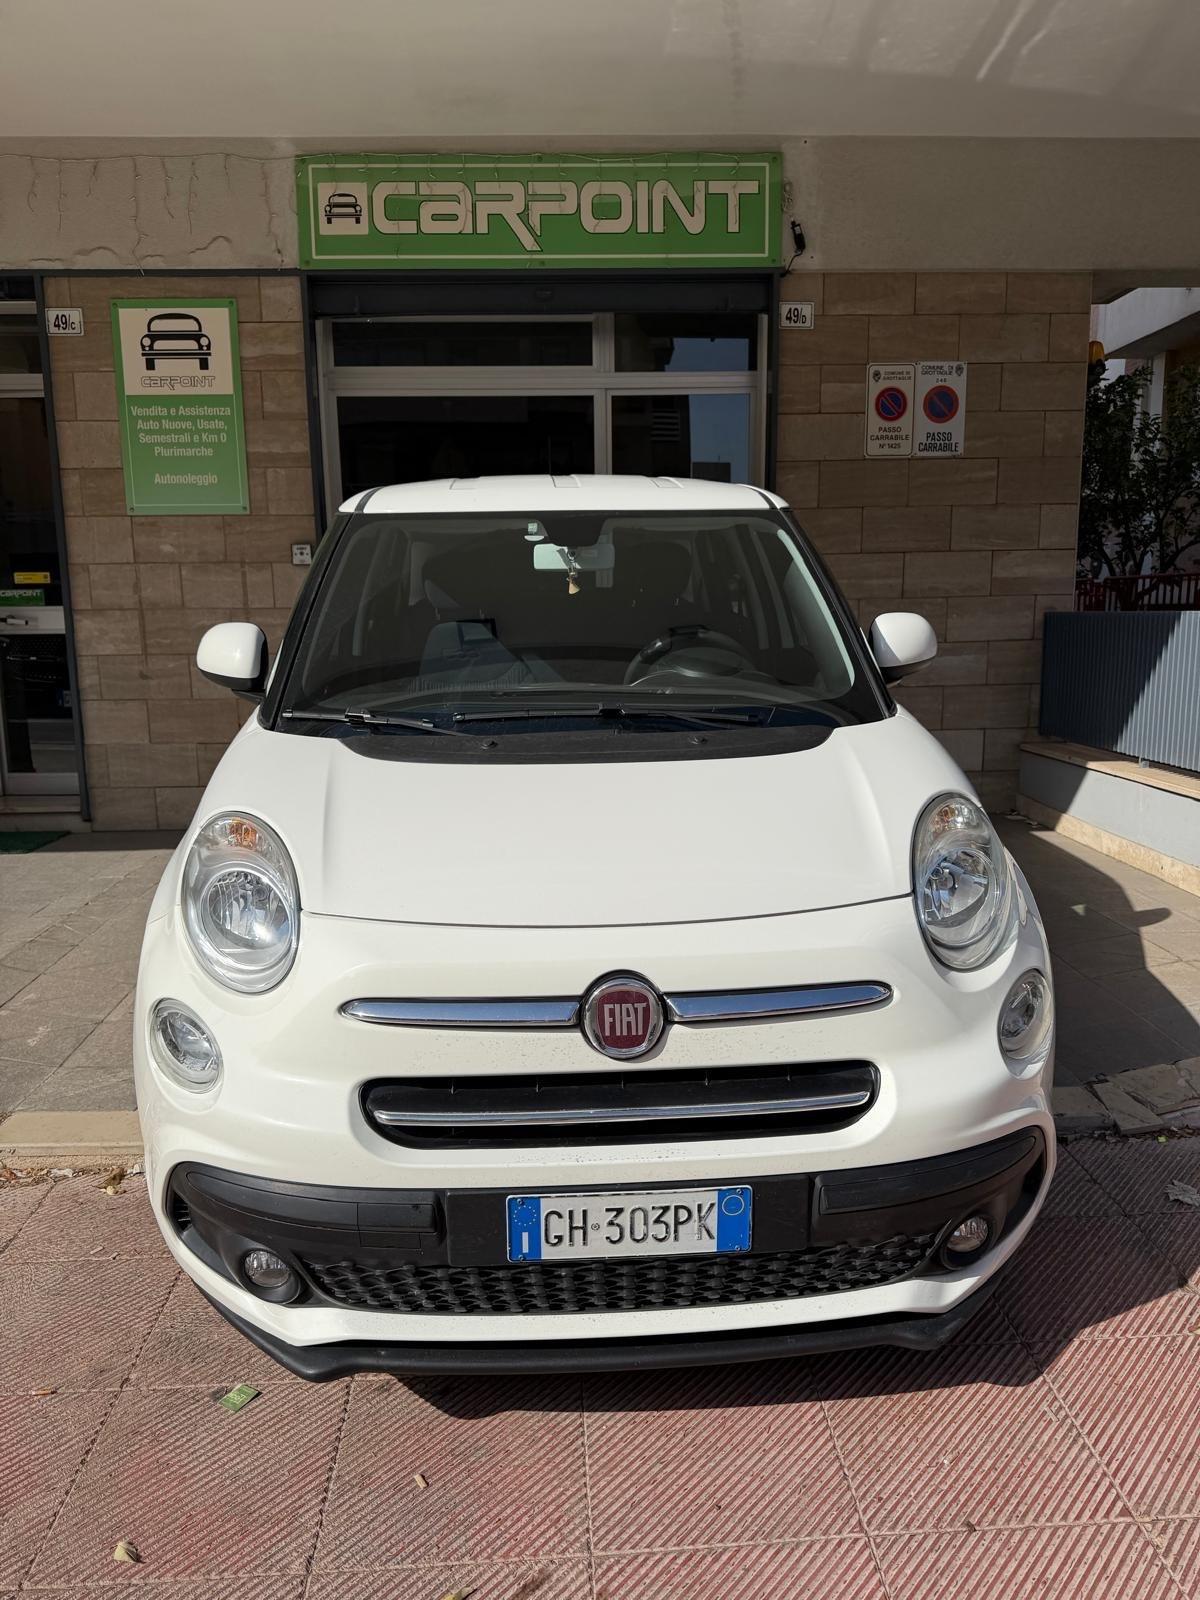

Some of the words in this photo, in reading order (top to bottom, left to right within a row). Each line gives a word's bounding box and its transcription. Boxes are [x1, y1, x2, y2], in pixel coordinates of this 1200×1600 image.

[131, 406, 168, 417] Vendita
[170, 408, 176, 416] e
[179, 405, 231, 416] Assistenza
[137, 419, 160, 430] Auto
[162, 419, 196, 432] Nuove,
[197, 419, 228, 431] Usate,
[139, 432, 191, 444] Semestrali
[193, 434, 200, 443] e
[202, 432, 217, 443] Km
[220, 432, 227, 443] 0
[926, 432, 952, 442] PASSO
[154, 446, 214, 457] Plurimarche
[918, 441, 960, 452] CARRABILE
[154, 473, 218, 486] Autonoleggio
[603, 1002, 647, 1037] FIAT
